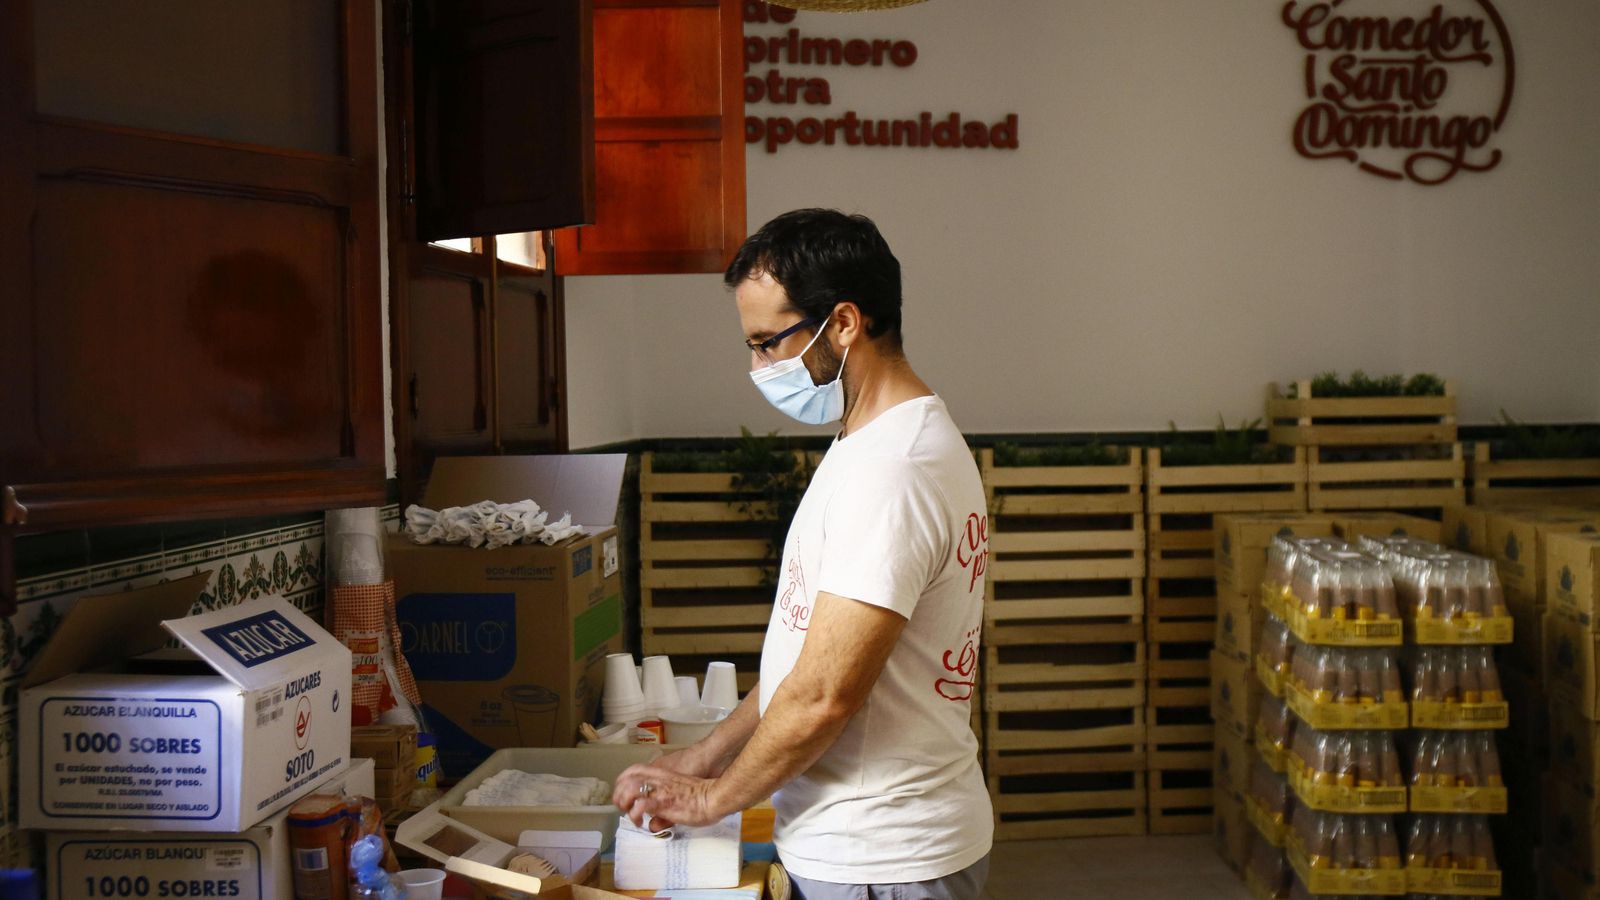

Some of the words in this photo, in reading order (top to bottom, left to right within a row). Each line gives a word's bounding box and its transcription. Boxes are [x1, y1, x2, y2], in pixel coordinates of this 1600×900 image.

[1283, 0, 1493, 67] Comedor
[743, 28, 918, 72] primero
[744, 69, 832, 105] otra
[1322, 54, 1448, 113] Santo
[745, 111, 1019, 153] oportunidad
[1293, 102, 1502, 186] Domingo
[401, 620, 473, 655] DARNEL
[285, 671, 321, 701] AZUCARES
[118, 706, 197, 718] BLANQUILLA
[63, 732, 122, 753] 1000
[129, 737, 202, 754] SOBRES
[104, 763, 160, 775] estuchado,
[161, 766, 173, 774] se
[176, 765, 207, 775] vende
[285, 749, 315, 782] SOTO
[59, 777, 77, 787] por
[80, 776, 137, 787] UNIDADES,
[139, 778, 152, 786] no
[155, 778, 173, 788] por
[175, 778, 203, 788] peso.
[118, 802, 145, 811] LUGAR
[175, 803, 210, 812] AISLADO
[146, 847, 207, 861] BLANQU
[85, 875, 150, 898] 1000
[158, 879, 240, 898] SOBRES
